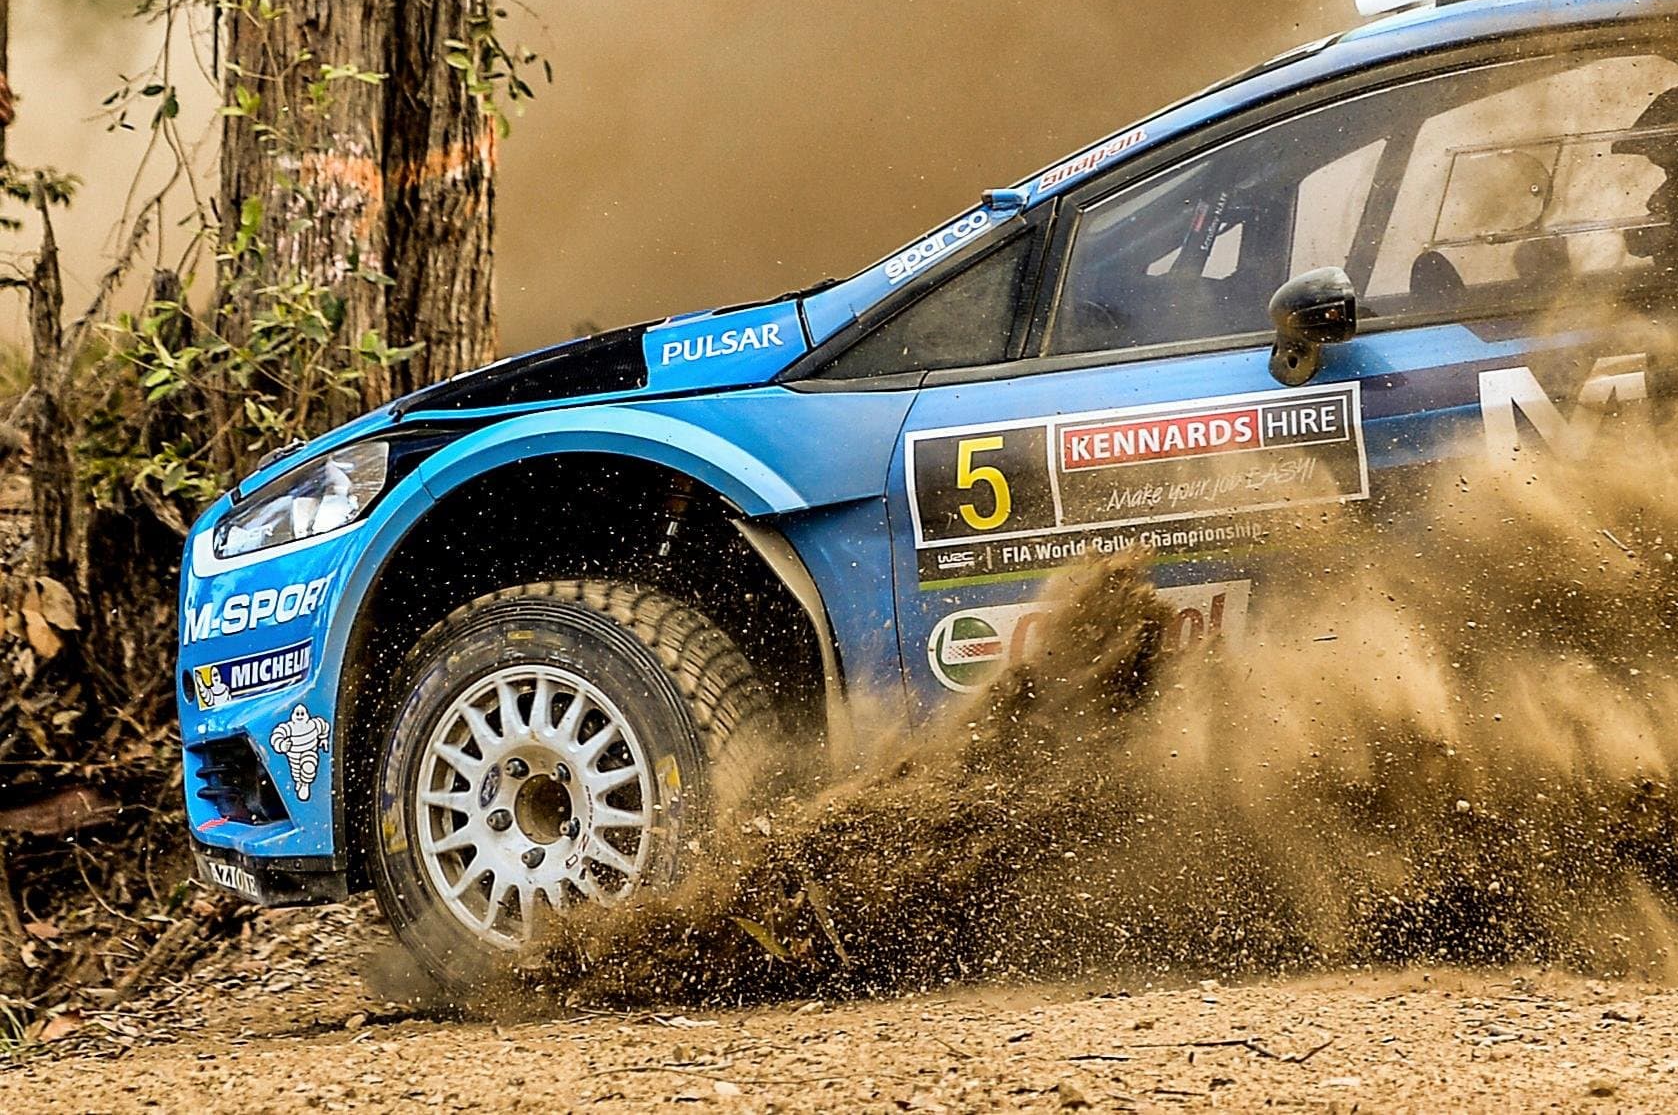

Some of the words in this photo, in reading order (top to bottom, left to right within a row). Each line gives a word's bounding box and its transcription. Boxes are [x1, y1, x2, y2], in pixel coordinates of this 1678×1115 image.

[884, 210, 990, 277] sparco
[661, 322, 783, 365] PULSAR
[1071, 416, 1253, 462] KENNARDS
[1266, 405, 1337, 439] HIRE
[955, 435, 1012, 531] 5
[1106, 481, 1164, 512] Make
[1168, 477, 1211, 508] your
[937, 551, 976, 566] WRC
[1002, 545, 1032, 564] FIA
[1036, 539, 1086, 561] World
[1140, 522, 1262, 548] Championship
[183, 568, 338, 646] M-SPORT
